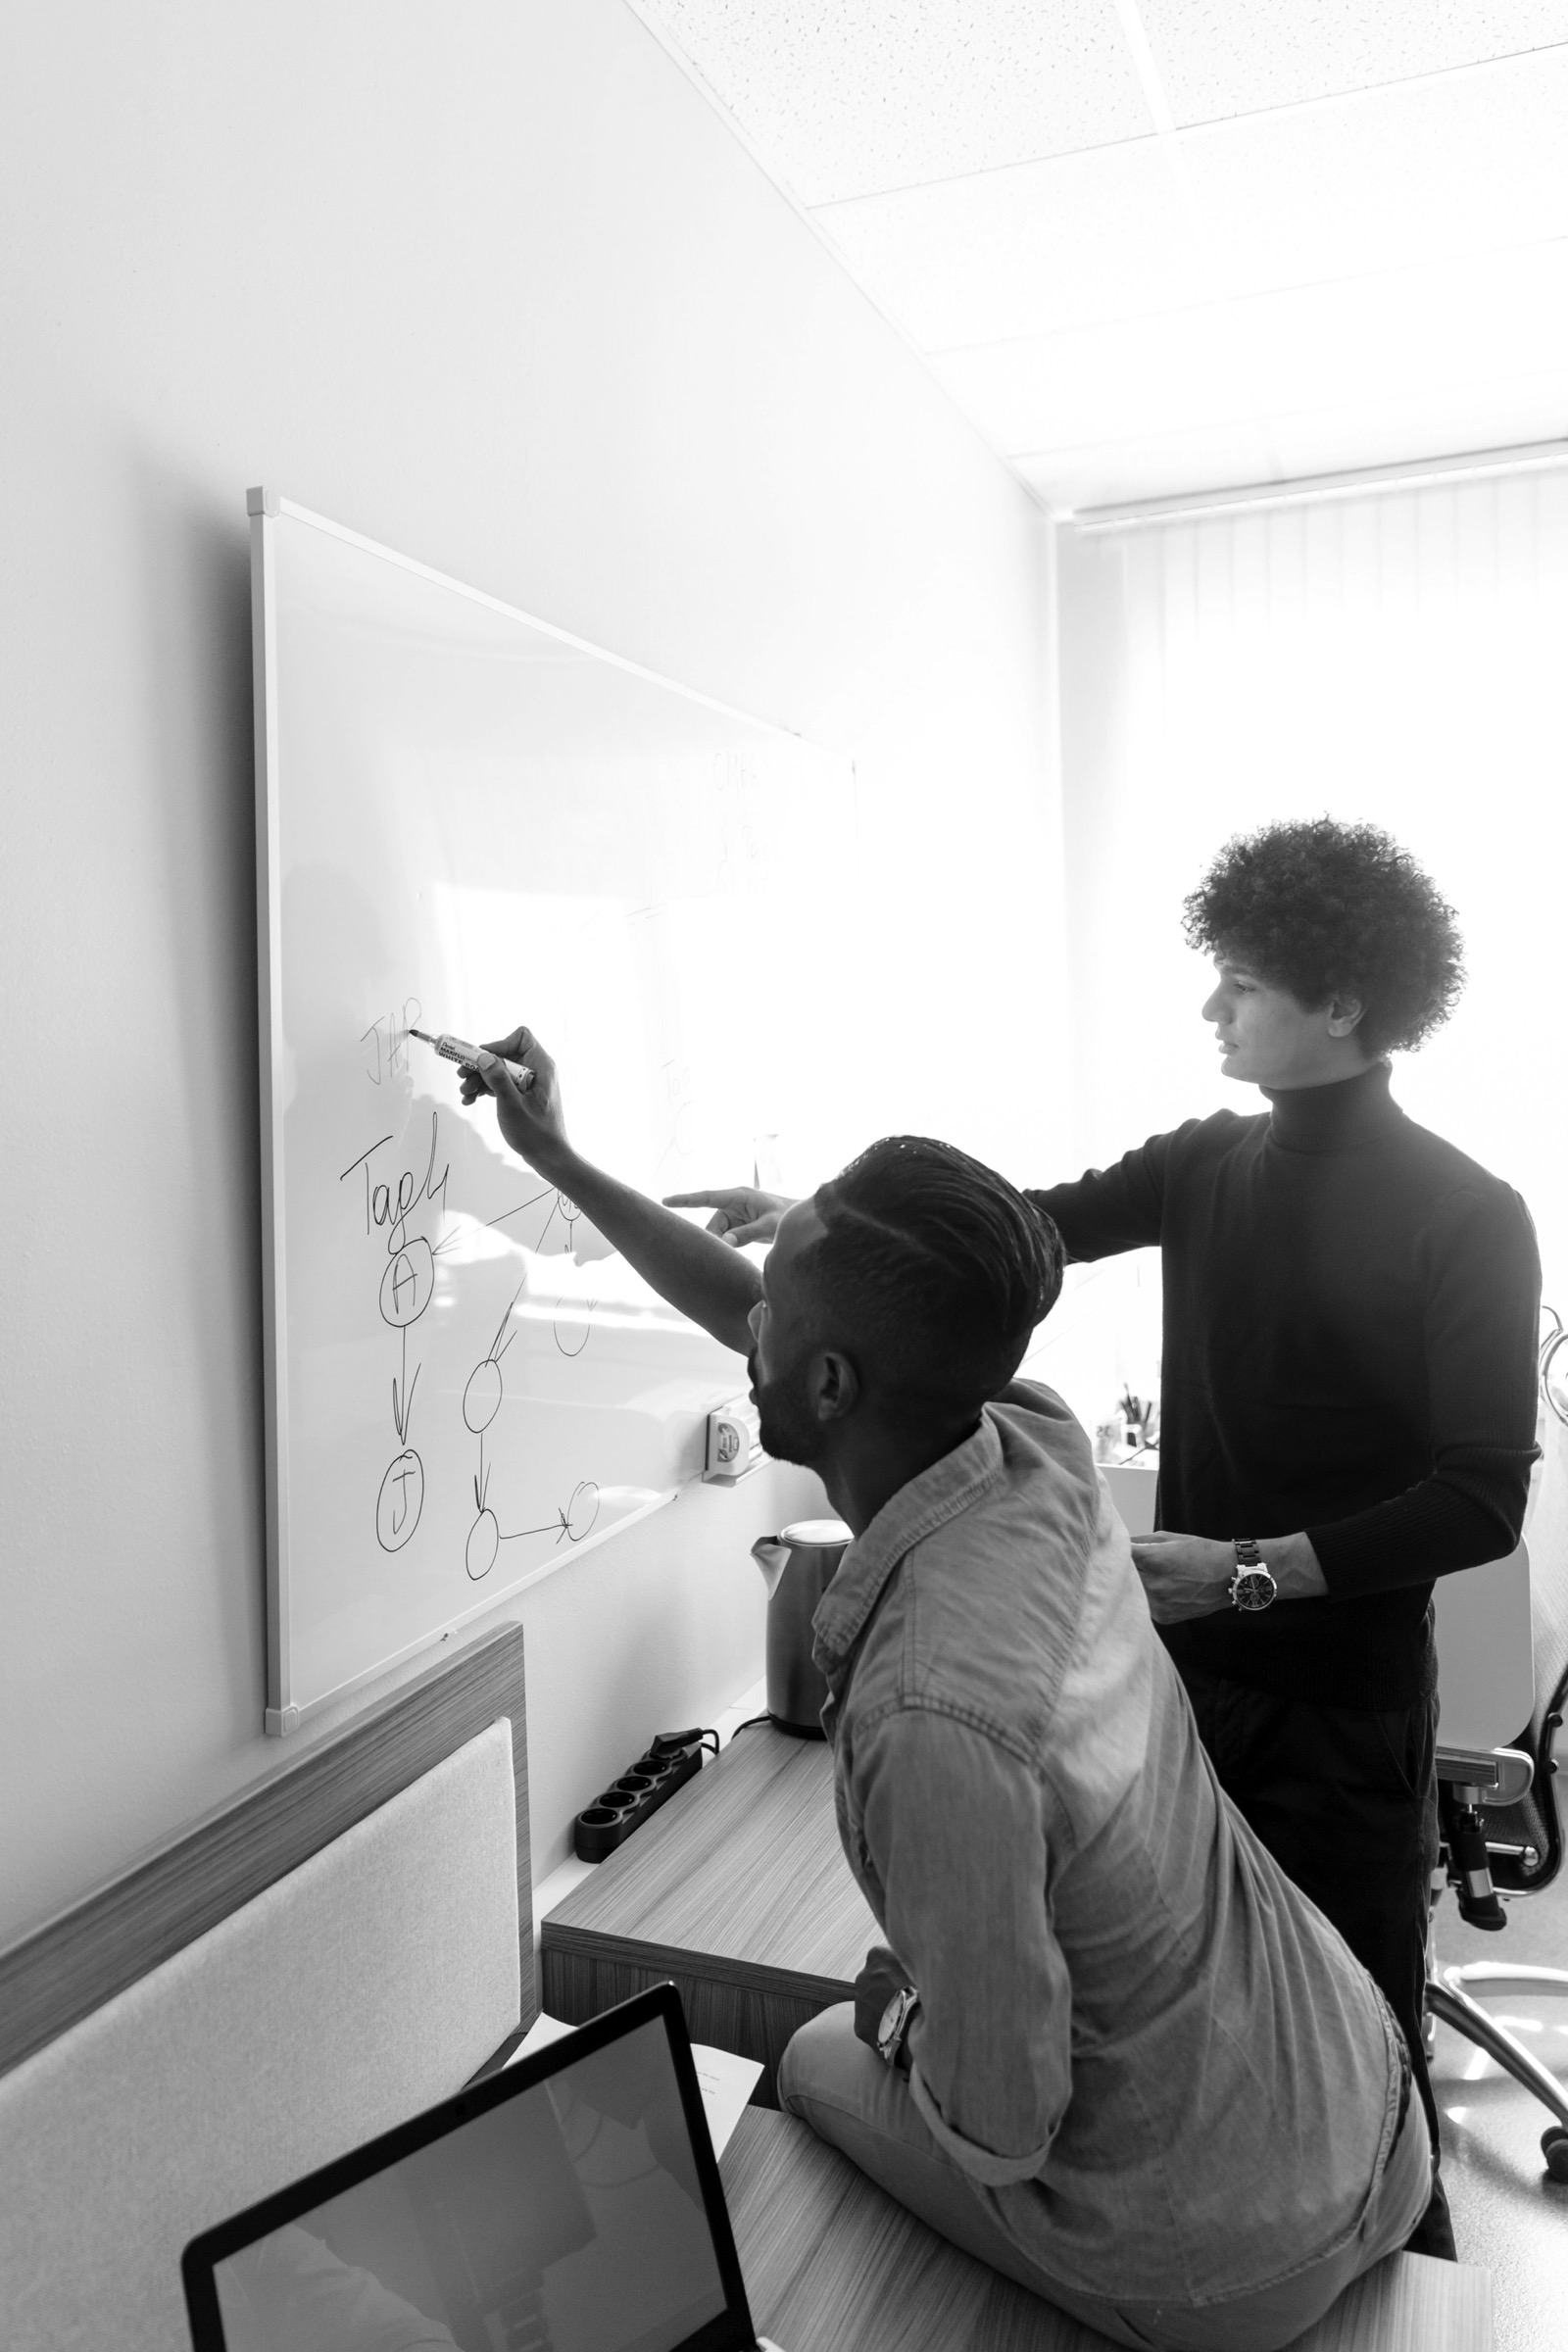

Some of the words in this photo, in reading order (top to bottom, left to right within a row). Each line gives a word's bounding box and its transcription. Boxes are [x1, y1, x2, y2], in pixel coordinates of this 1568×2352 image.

[438, 1051, 463, 1064] WHITE
[465, 1062, 480, 1073] BOA
[392, 1252, 418, 1315] A
